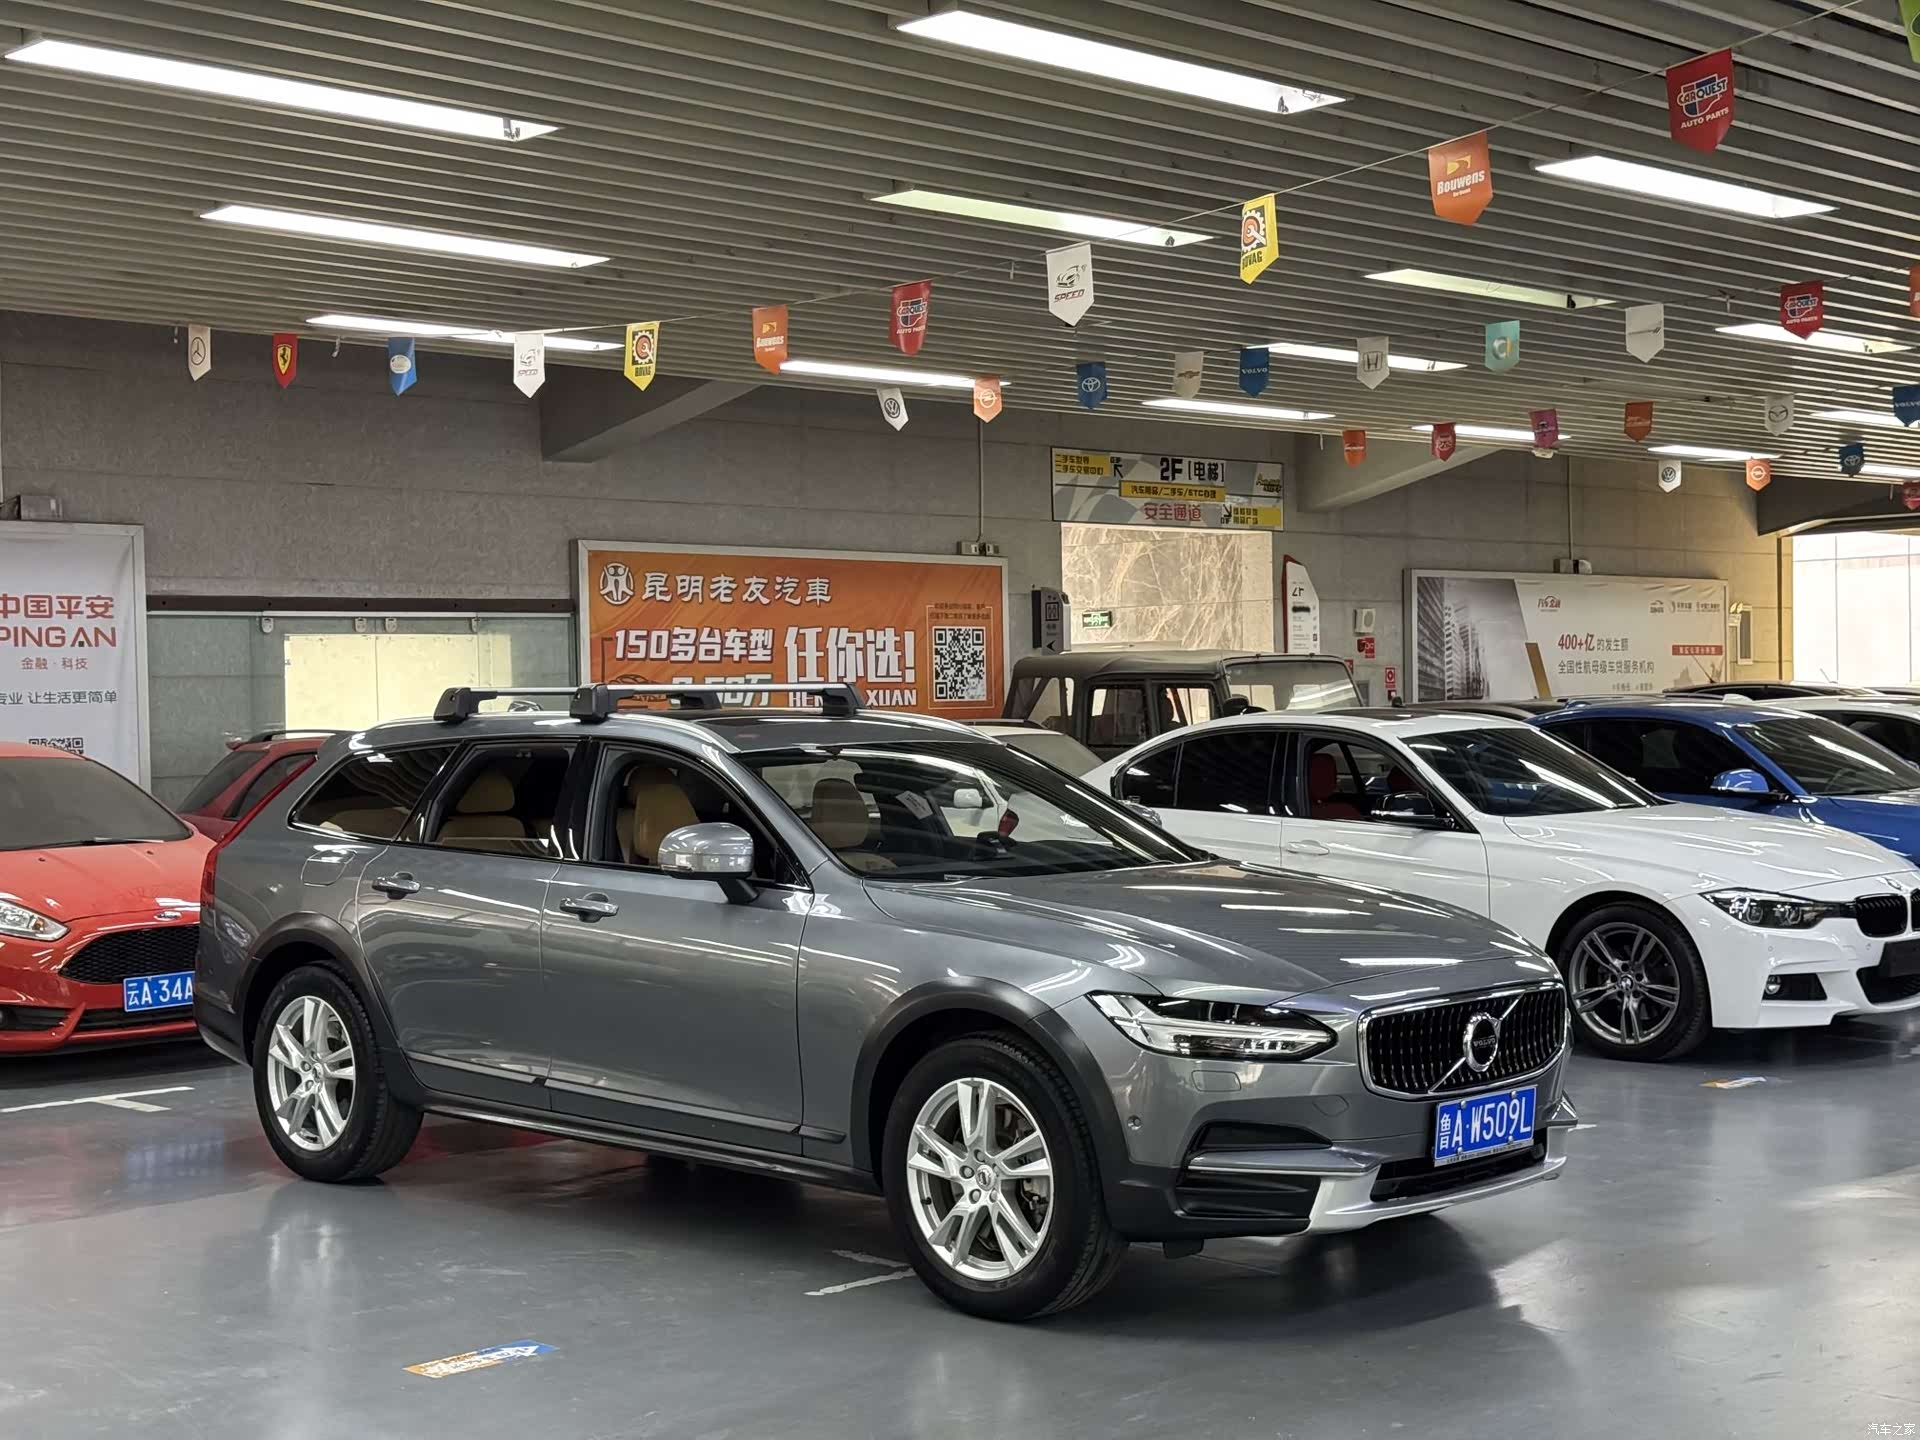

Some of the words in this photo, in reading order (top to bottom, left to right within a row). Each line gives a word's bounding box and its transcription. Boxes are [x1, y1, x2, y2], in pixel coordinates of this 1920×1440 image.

[1678, 79, 1727, 105] CARQUEST
[1681, 118, 1704, 129] AUTO
[1706, 107, 1729, 122] PARTS
[1437, 170, 1485, 196] Bouwens
[1054, 289, 1085, 303] SPEED
[1160, 457, 1183, 481] 2F
[1144, 502, 1201, 521] 安全通道
[0, 593, 114, 619] 中国平安
[1558, 633, 1595, 652] 400+亿
[615, 626, 774, 663] 150多台车型
[784, 625, 916, 683] 任你选!
[28, 691, 117, 704] 让生活更简单
[865, 689, 917, 706] XUAN
